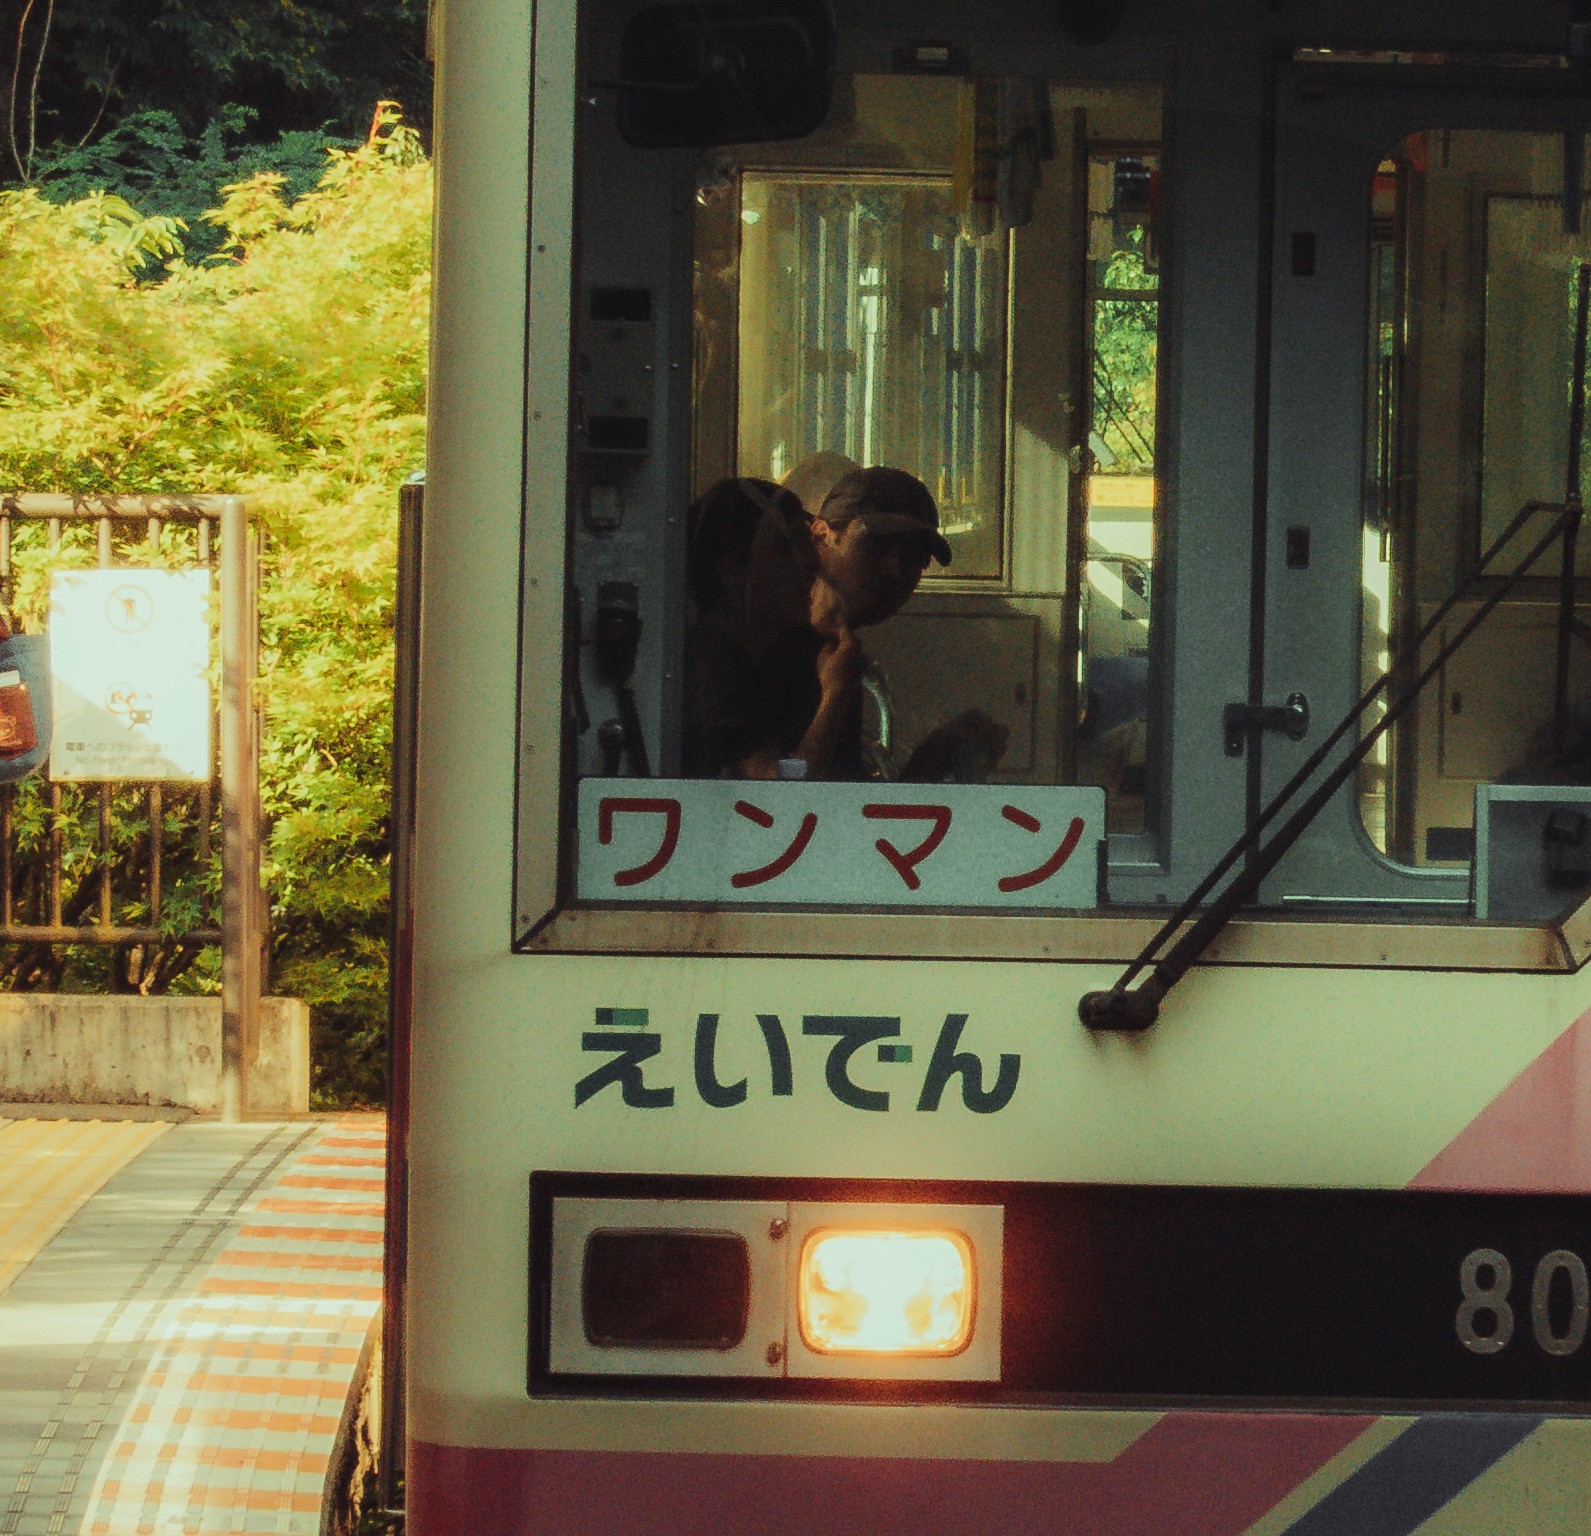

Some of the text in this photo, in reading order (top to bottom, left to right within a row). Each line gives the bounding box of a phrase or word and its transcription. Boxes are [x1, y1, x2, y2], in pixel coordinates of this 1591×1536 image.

[600, 797, 1084, 892] ワンマン
[575, 1007, 1021, 1114] えいでん
